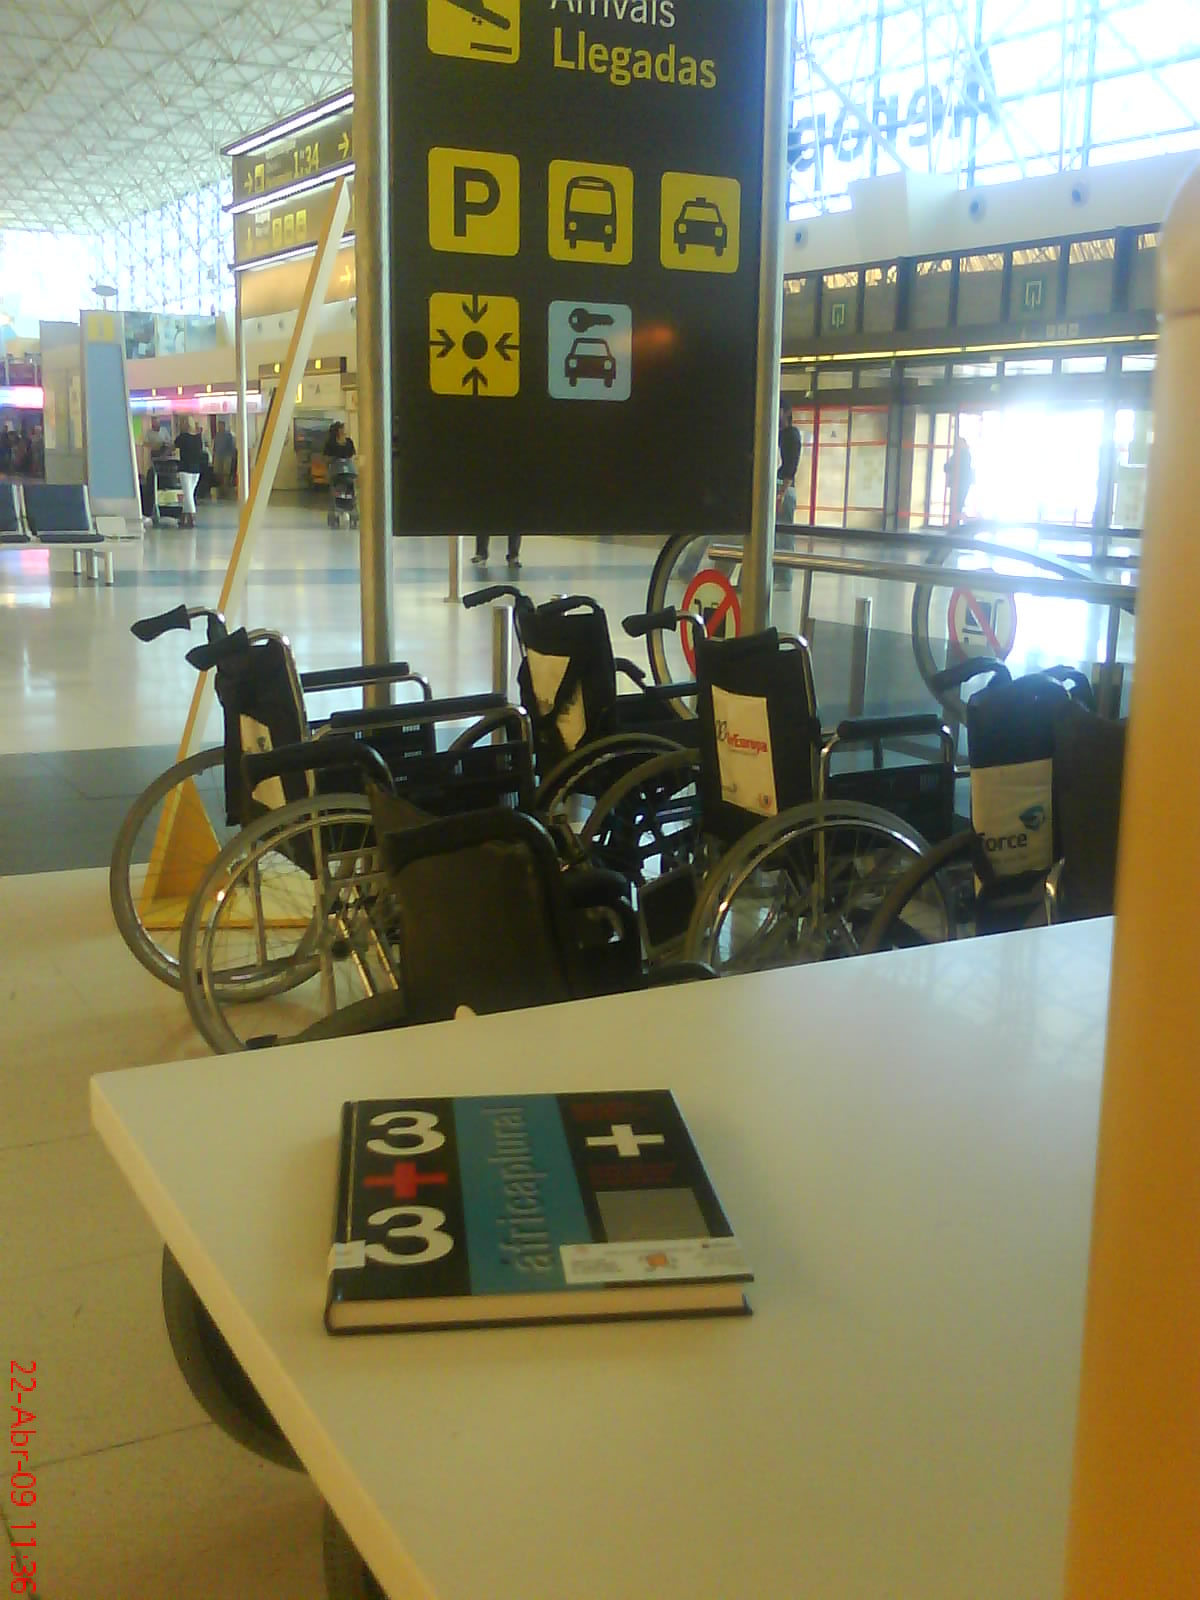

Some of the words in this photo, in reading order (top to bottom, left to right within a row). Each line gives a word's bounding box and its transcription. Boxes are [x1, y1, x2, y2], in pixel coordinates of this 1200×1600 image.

[553, 27, 717, 88] Llegadas
[453, 166, 501, 237] P
[366, 1110, 446, 1156] 3
[365, 1205, 454, 1265] 3
